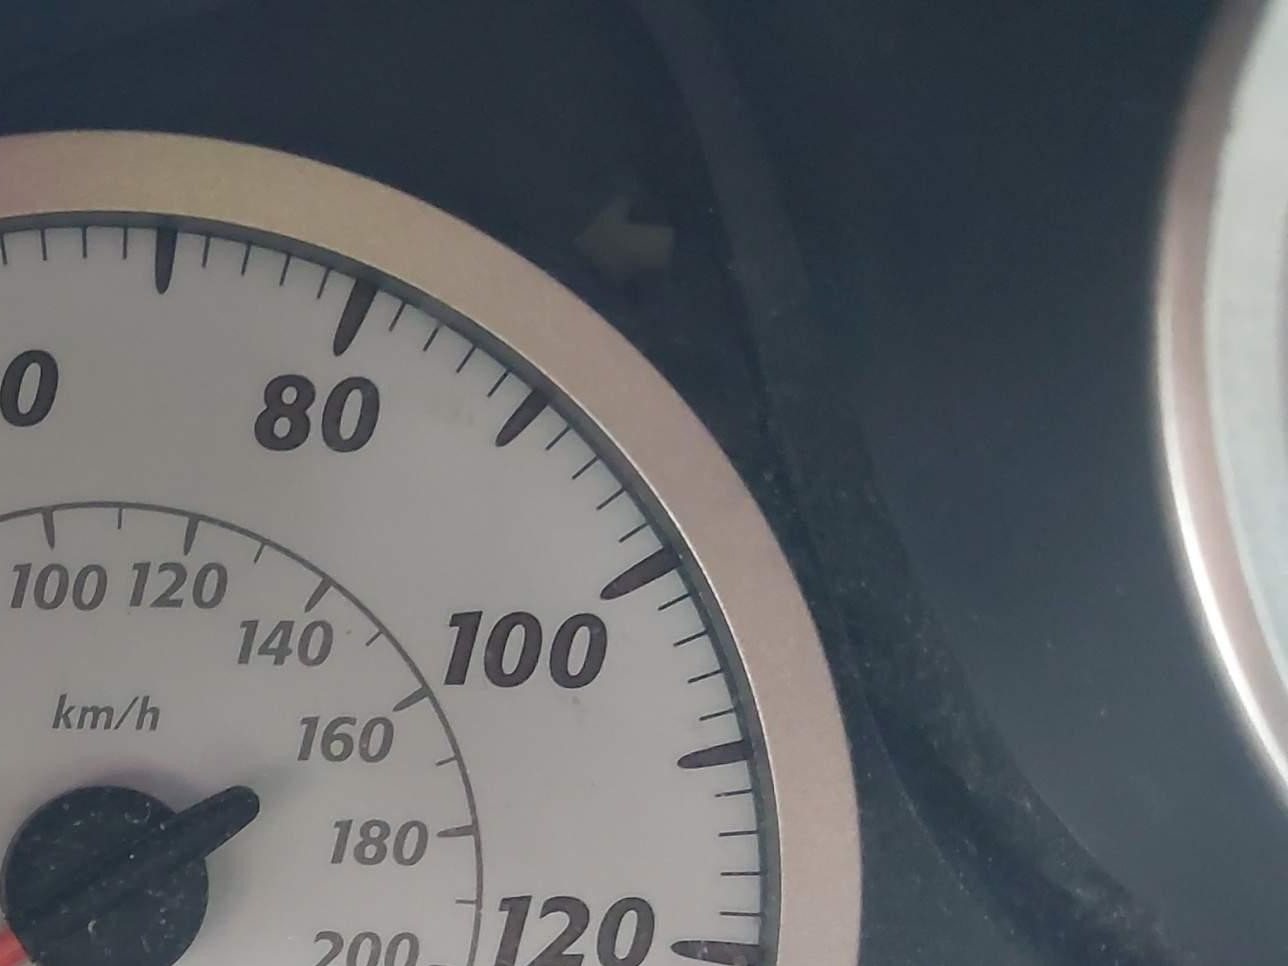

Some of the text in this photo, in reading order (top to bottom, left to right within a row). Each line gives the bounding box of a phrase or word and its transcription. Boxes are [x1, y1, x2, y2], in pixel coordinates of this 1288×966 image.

[254, 374, 381, 453] 80
[11, 563, 108, 611] 100
[130, 562, 228, 610] 120
[238, 620, 334, 667] 140
[444, 611, 608, 689] 100
[52, 694, 161, 731] km/h
[297, 716, 395, 763] 160
[331, 819, 428, 867] 180
